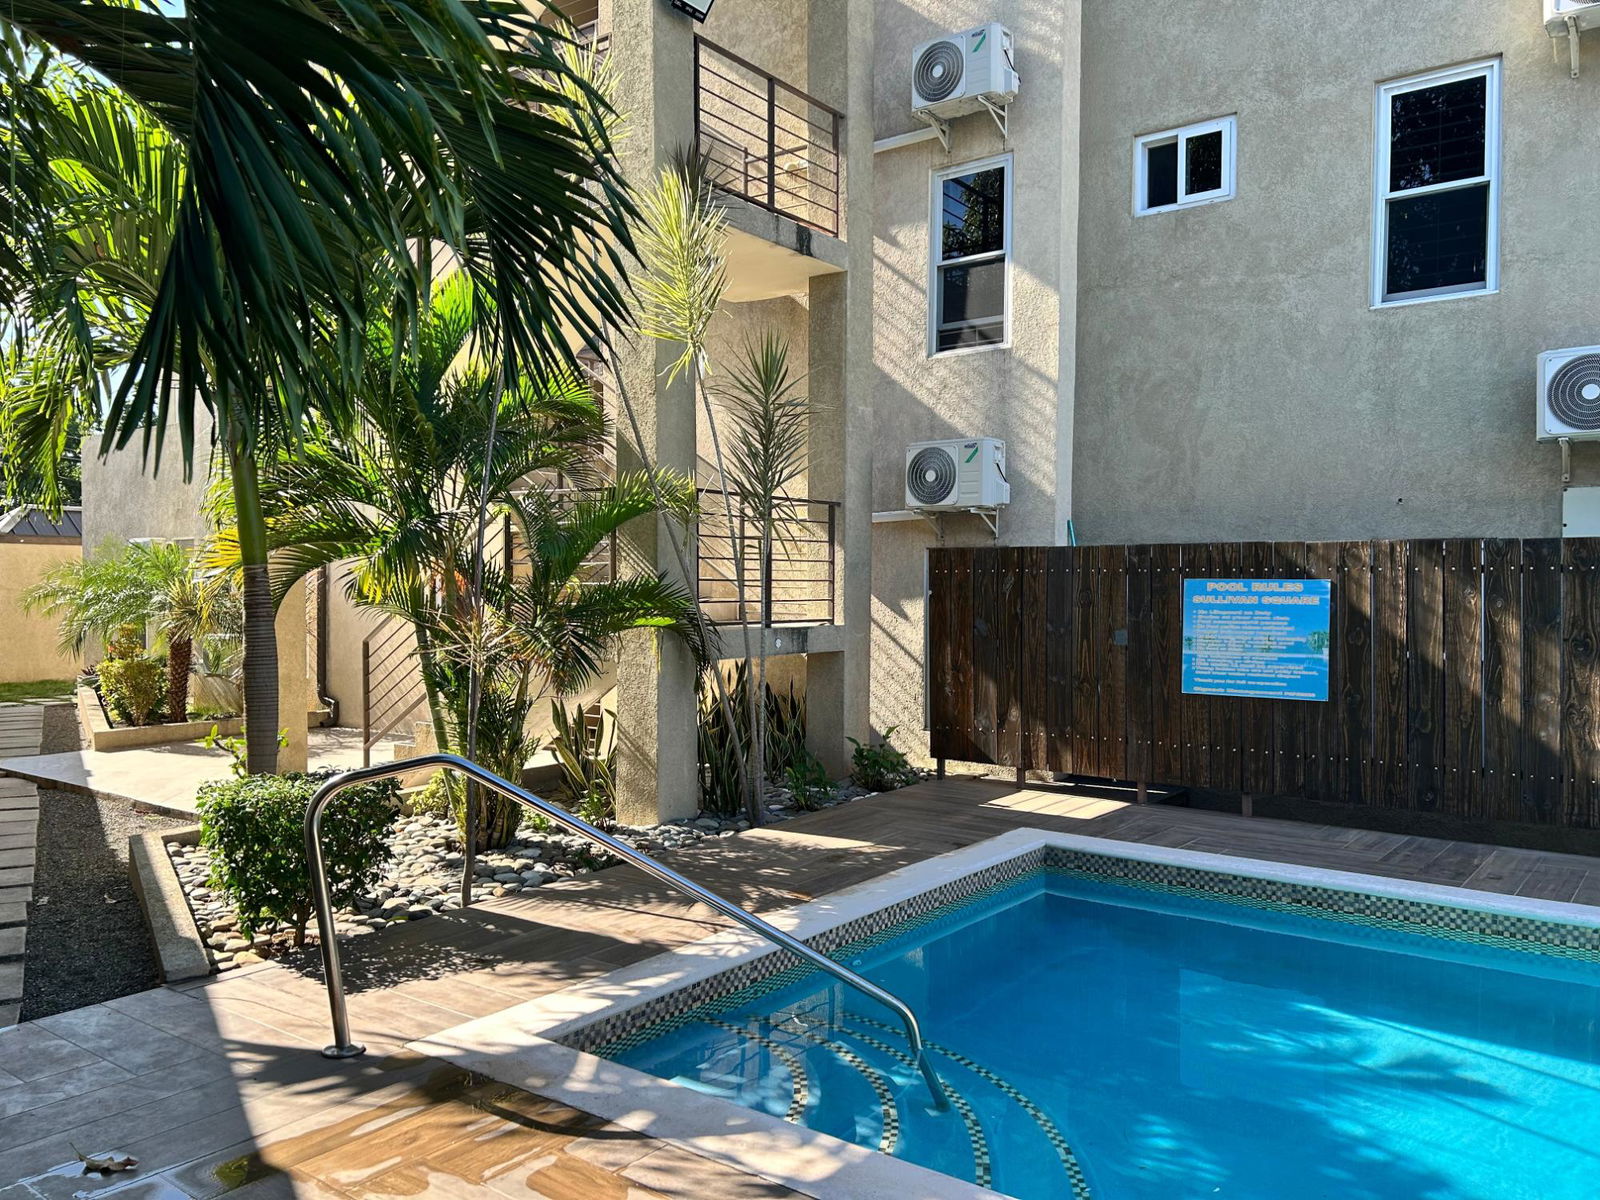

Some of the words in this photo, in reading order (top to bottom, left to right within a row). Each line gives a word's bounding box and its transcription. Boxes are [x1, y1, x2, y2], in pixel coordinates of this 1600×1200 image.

[1207, 582, 1248, 592] POOL
[1252, 582, 1304, 592] RULES
[1192, 595, 1258, 604] SULLIVAN
[1262, 596, 1320, 605] SQUARE
